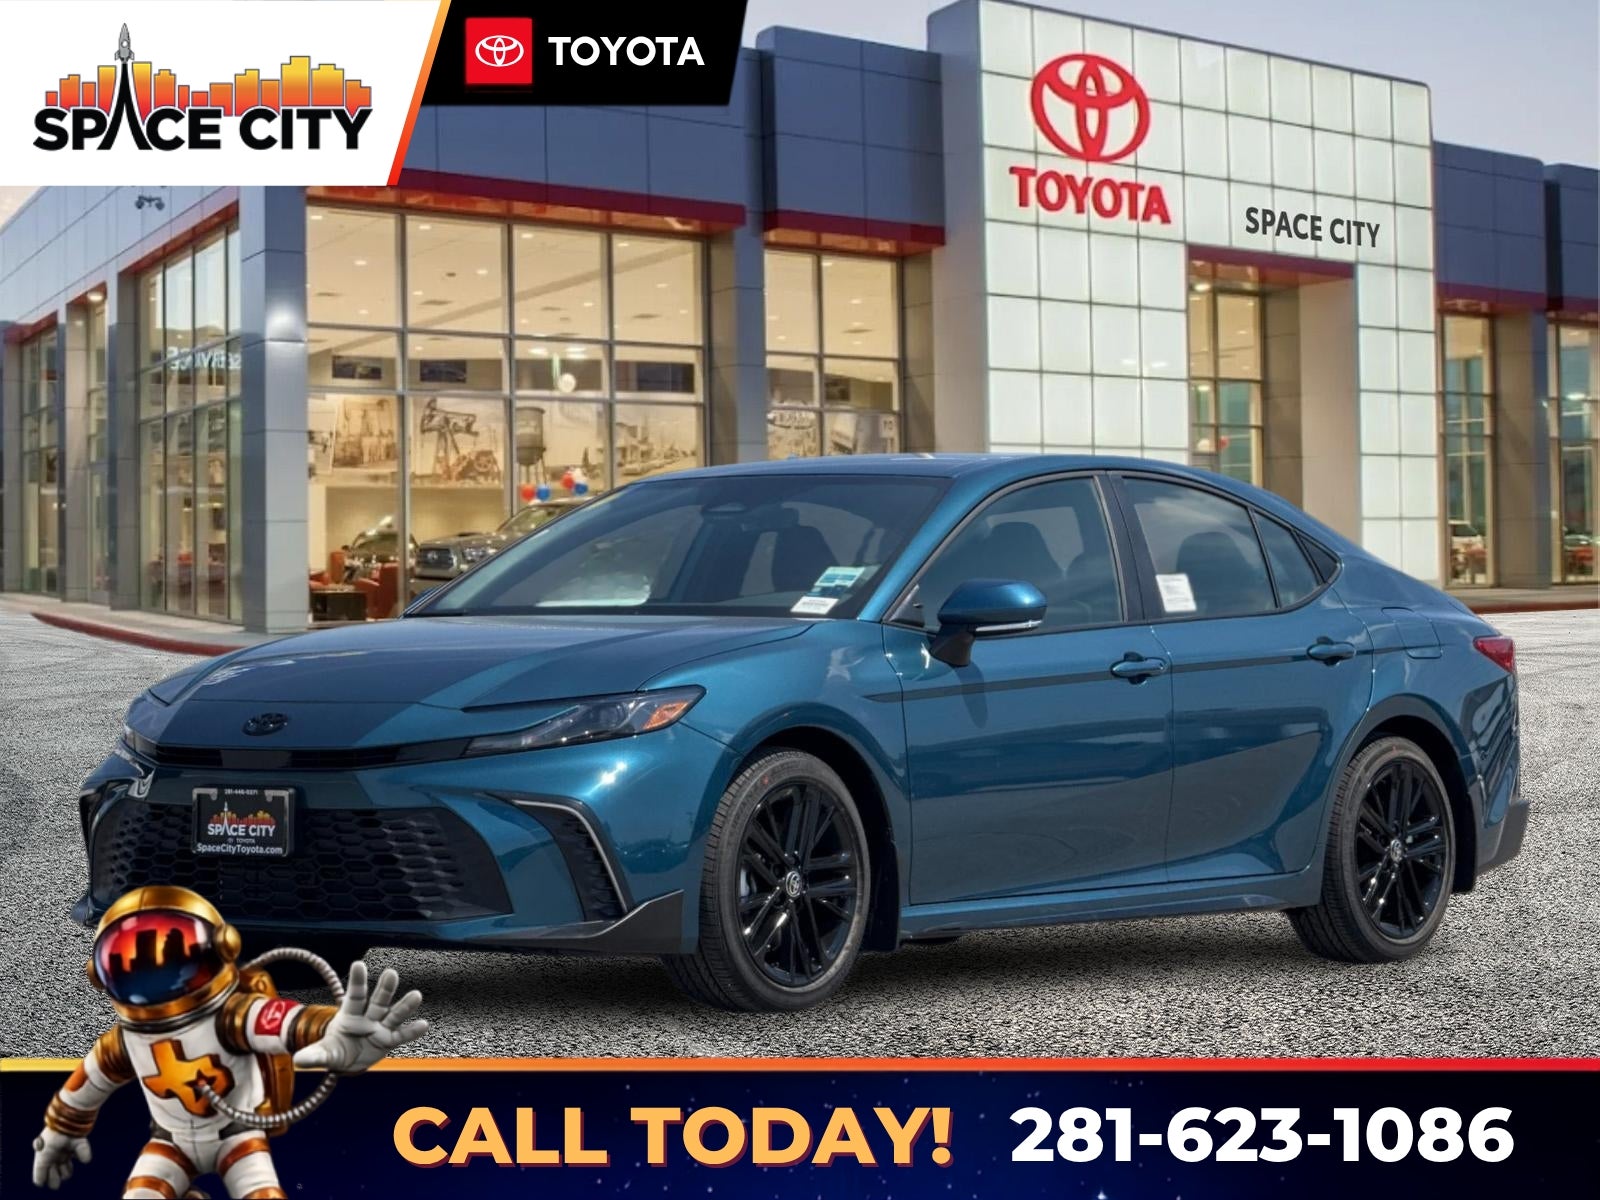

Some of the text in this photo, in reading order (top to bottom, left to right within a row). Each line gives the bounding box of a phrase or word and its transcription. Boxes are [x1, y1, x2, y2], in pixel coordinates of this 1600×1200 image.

[1009, 166, 1171, 225] TOYOTA
[1245, 207, 1380, 248] SPACE CITY
[207, 822, 276, 837] SPACE CITY
[197, 842, 283, 855] SpaceCityToyota.com
